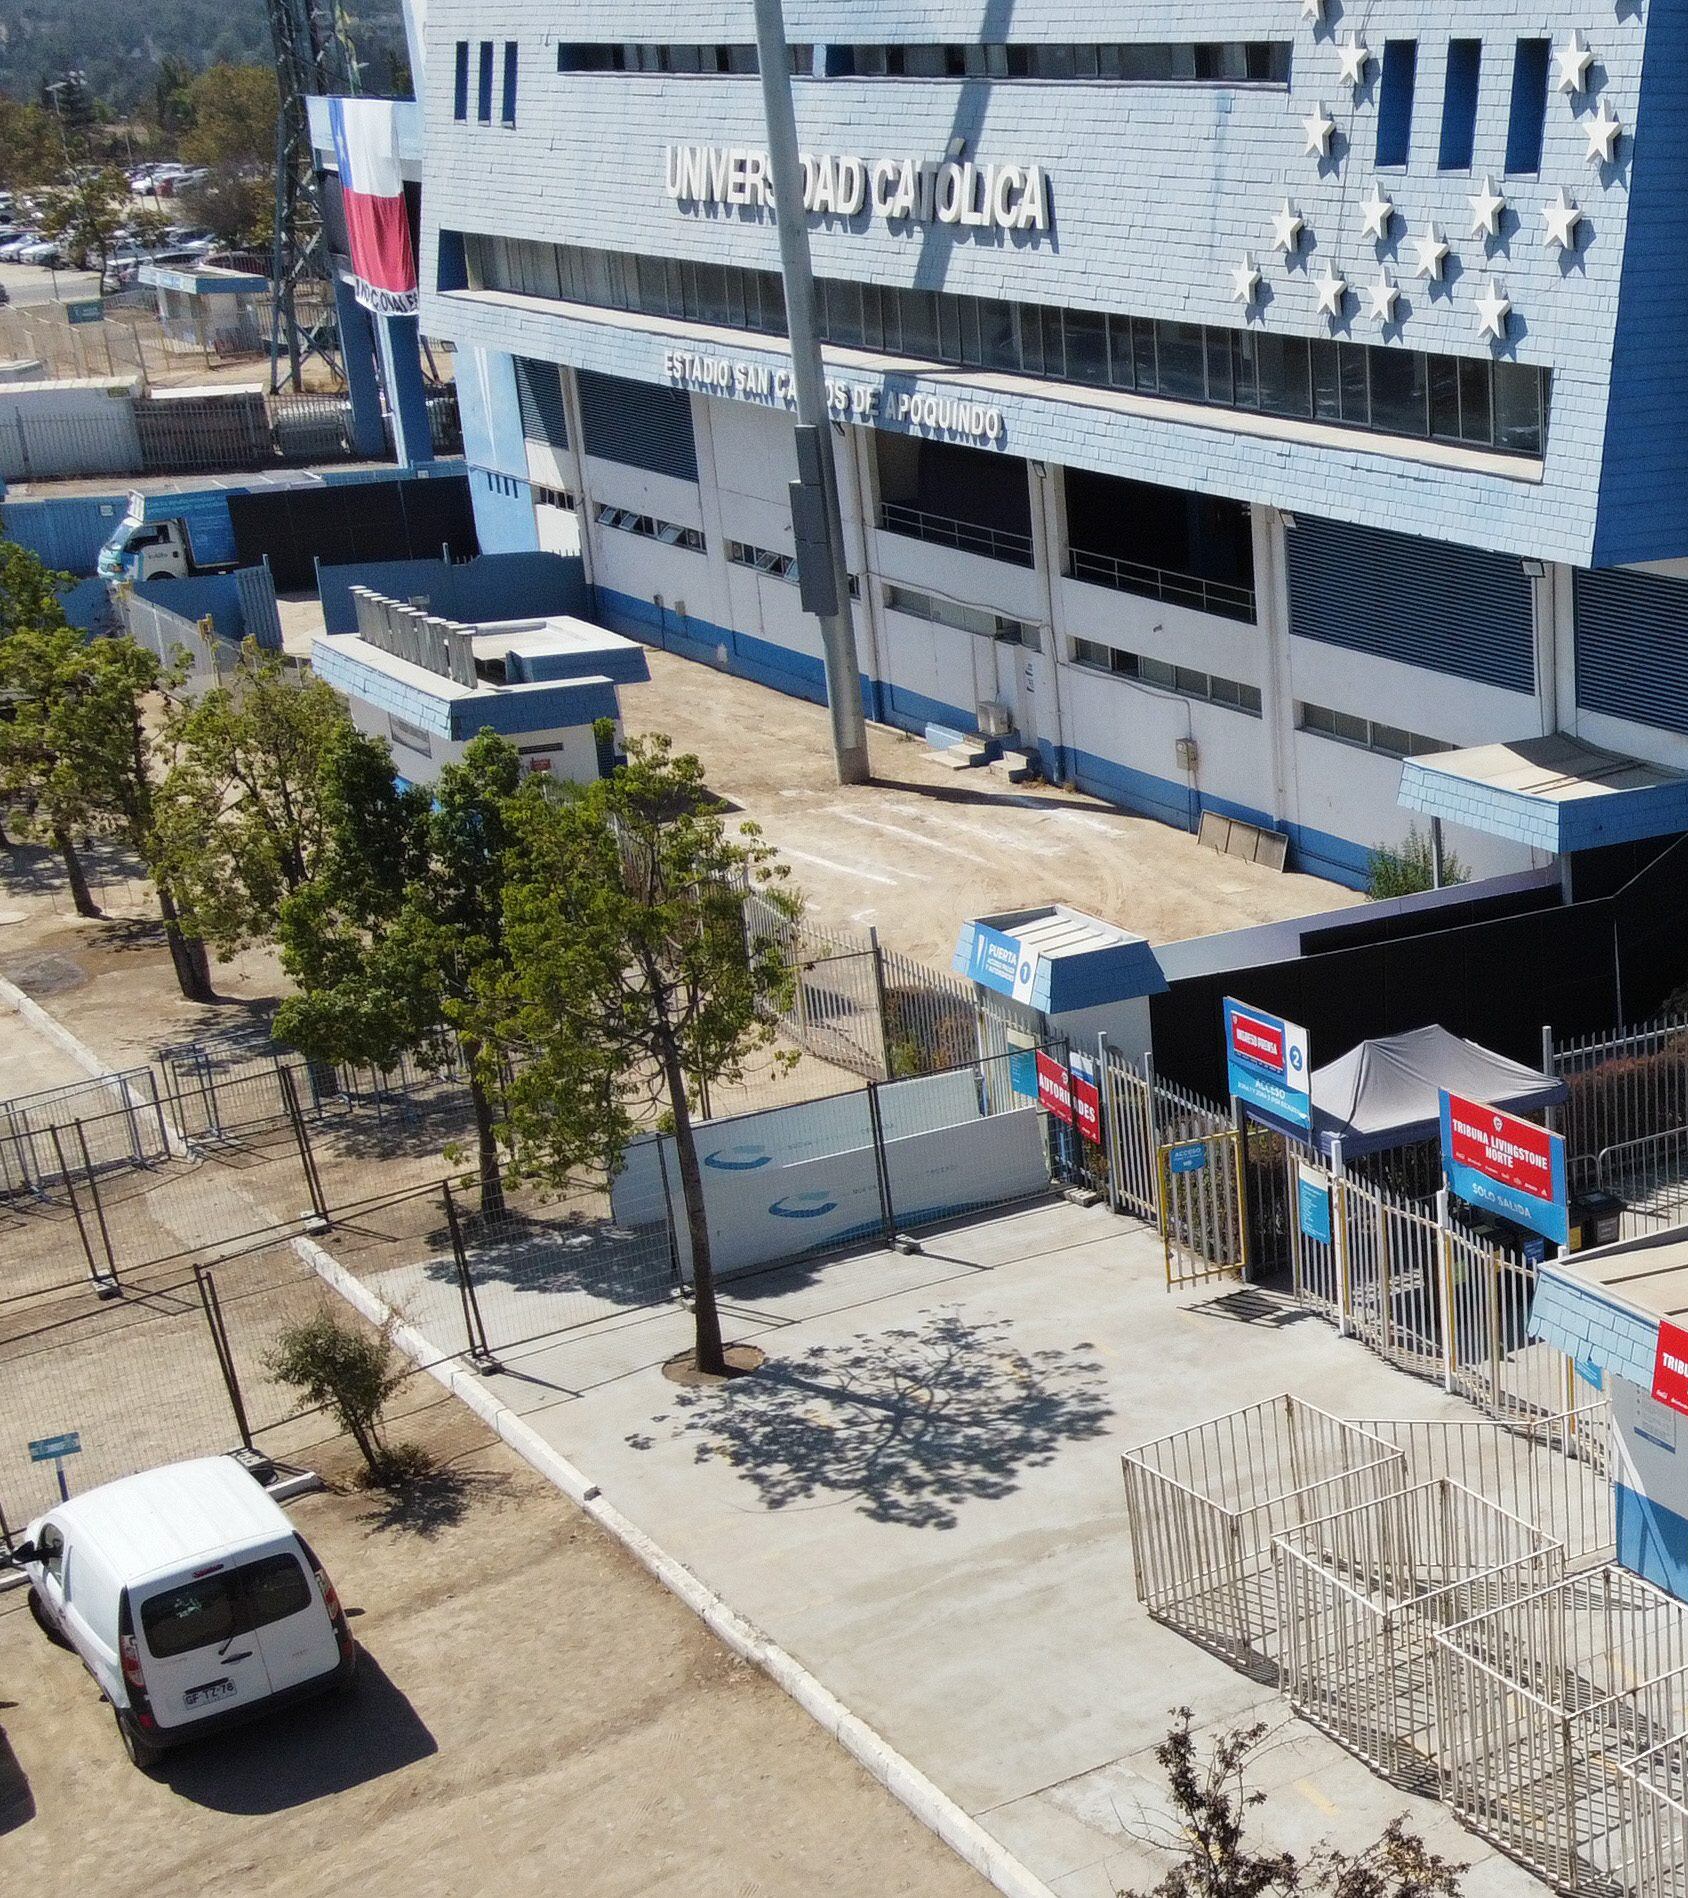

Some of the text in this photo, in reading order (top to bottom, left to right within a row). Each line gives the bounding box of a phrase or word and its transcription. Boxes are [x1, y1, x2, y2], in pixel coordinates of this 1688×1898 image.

[666, 138, 1049, 229] UNIVERSDAD CATÓLICA
[665, 351, 1004, 439] ESTADIO SAN CAOS DE APOQUINDO
[989, 943, 1017, 966] PUERTA
[1292, 1051, 1299, 1067] 2
[1039, 1072, 1096, 1123] AUTORIADES
[1452, 1119, 1548, 1170] TRIBUNA LIVINGSTONE
[1485, 1146, 1514, 1168] NORTE
[1472, 1183, 1532, 1219] SOLO SALIDA
